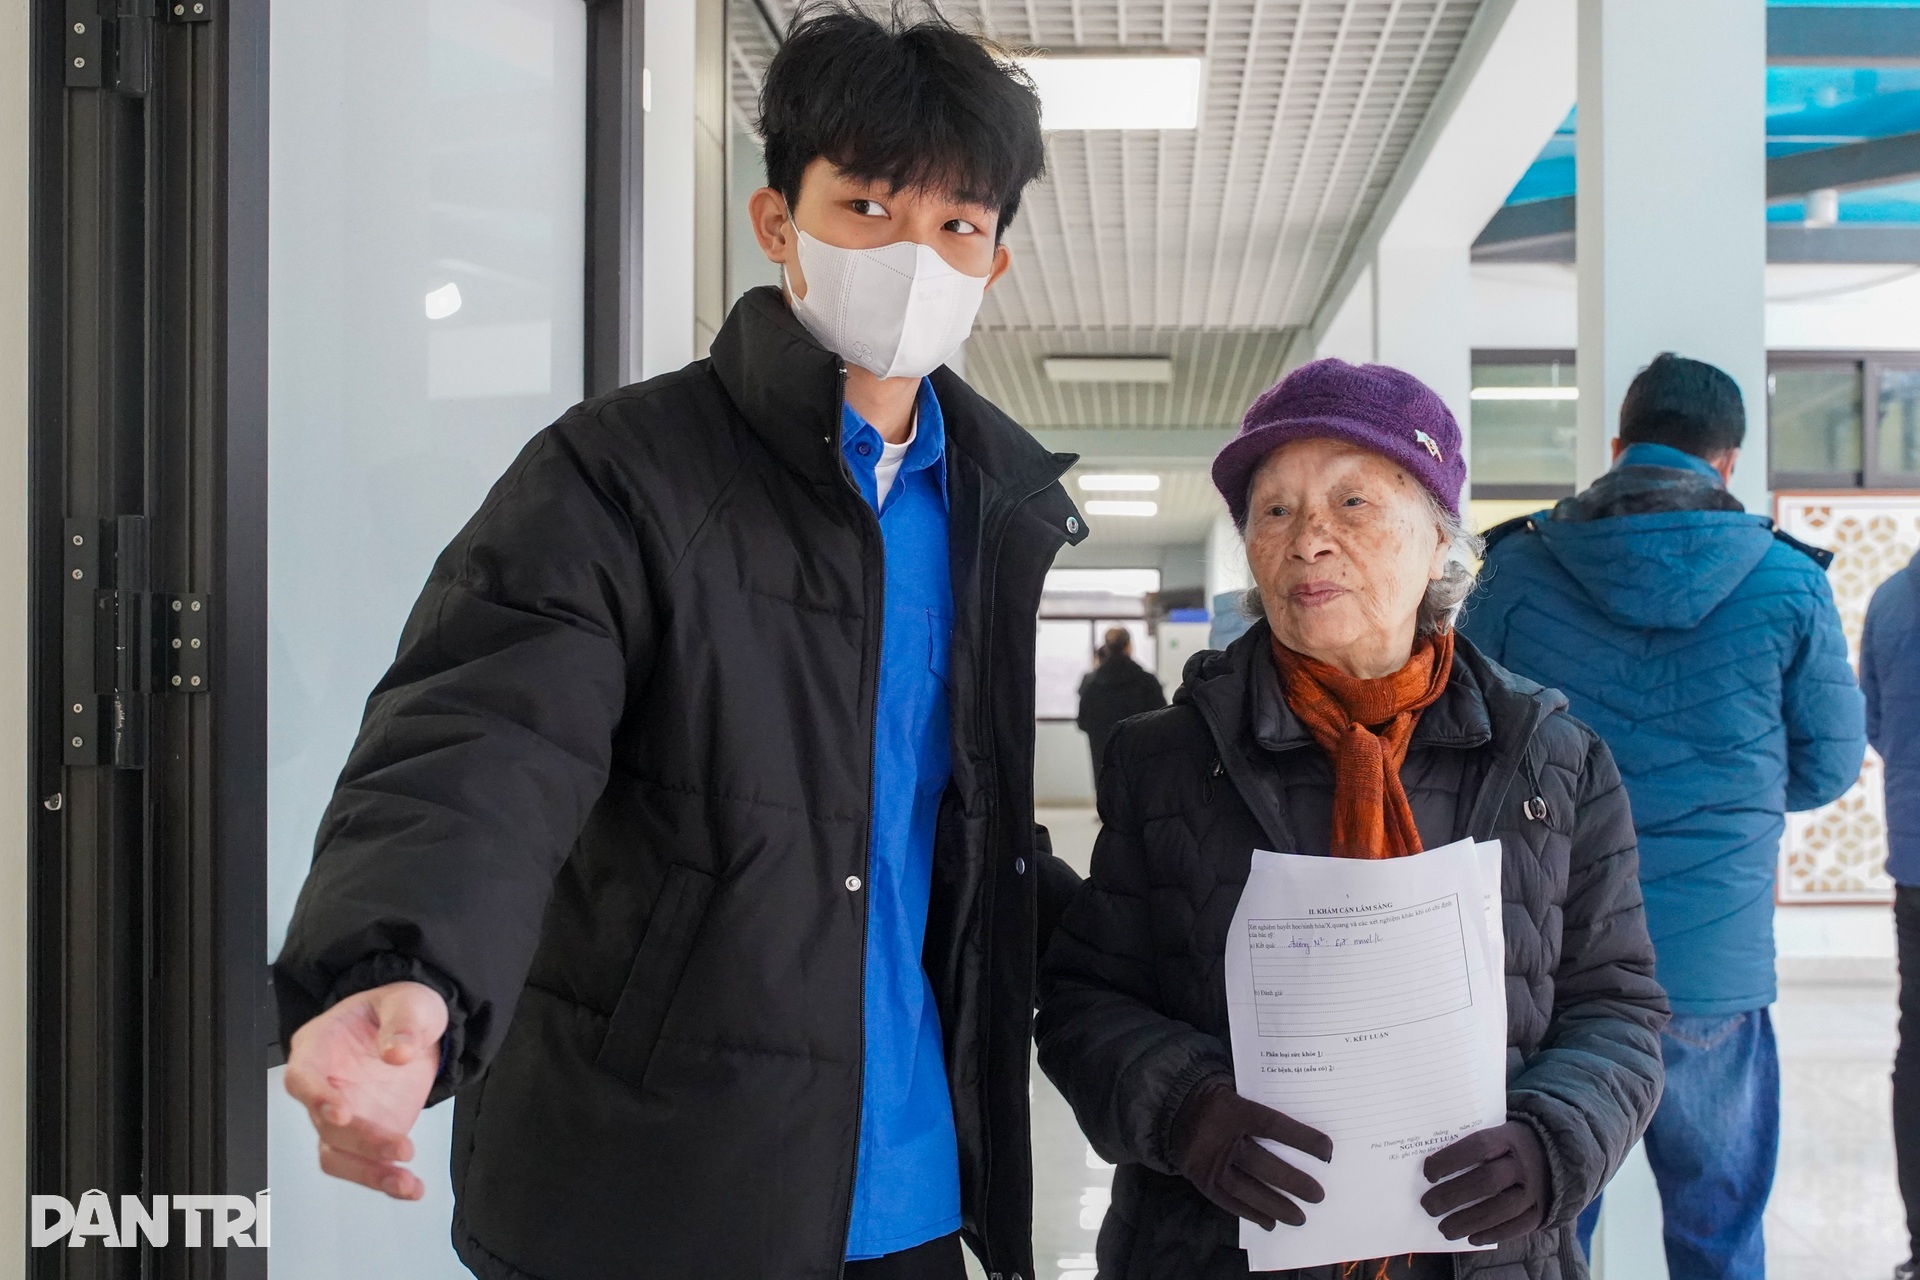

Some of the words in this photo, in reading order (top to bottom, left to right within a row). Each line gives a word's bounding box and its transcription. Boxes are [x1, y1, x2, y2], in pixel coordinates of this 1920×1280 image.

[1380, 916, 1400, 924] nghiệm
[1441, 900, 1452, 909] định
[1370, 1032, 1389, 1040] LUẬN
[1424, 1137, 1438, 1145] KẾT
[1440, 1133, 1459, 1142] LUẬN
